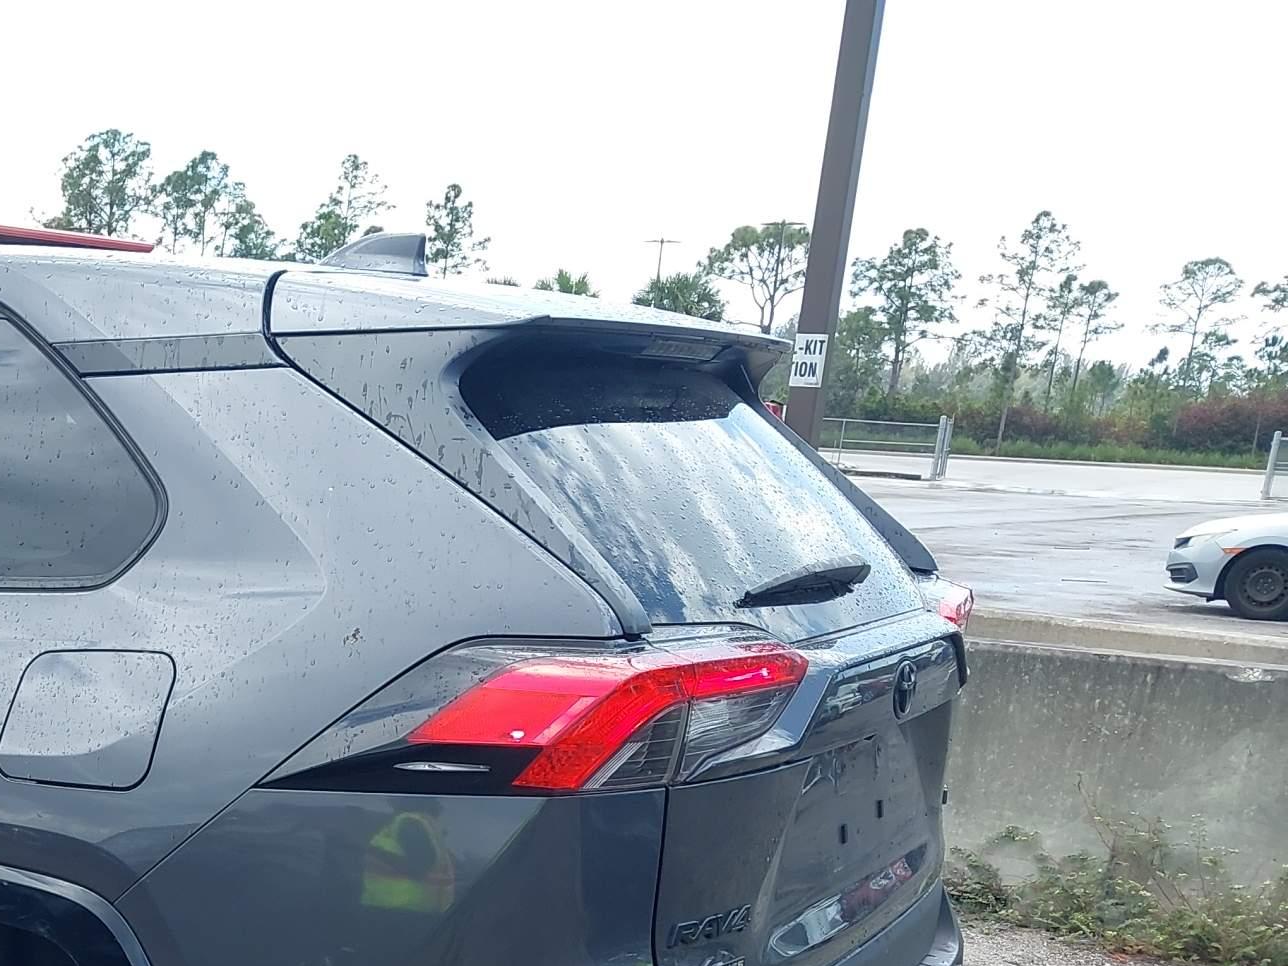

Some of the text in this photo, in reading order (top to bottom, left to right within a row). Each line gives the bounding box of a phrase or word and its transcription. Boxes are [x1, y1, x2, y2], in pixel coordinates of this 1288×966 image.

[794, 339, 826, 356] -KIT
[792, 361, 818, 378] ION
[666, 904, 752, 949] RAV4
